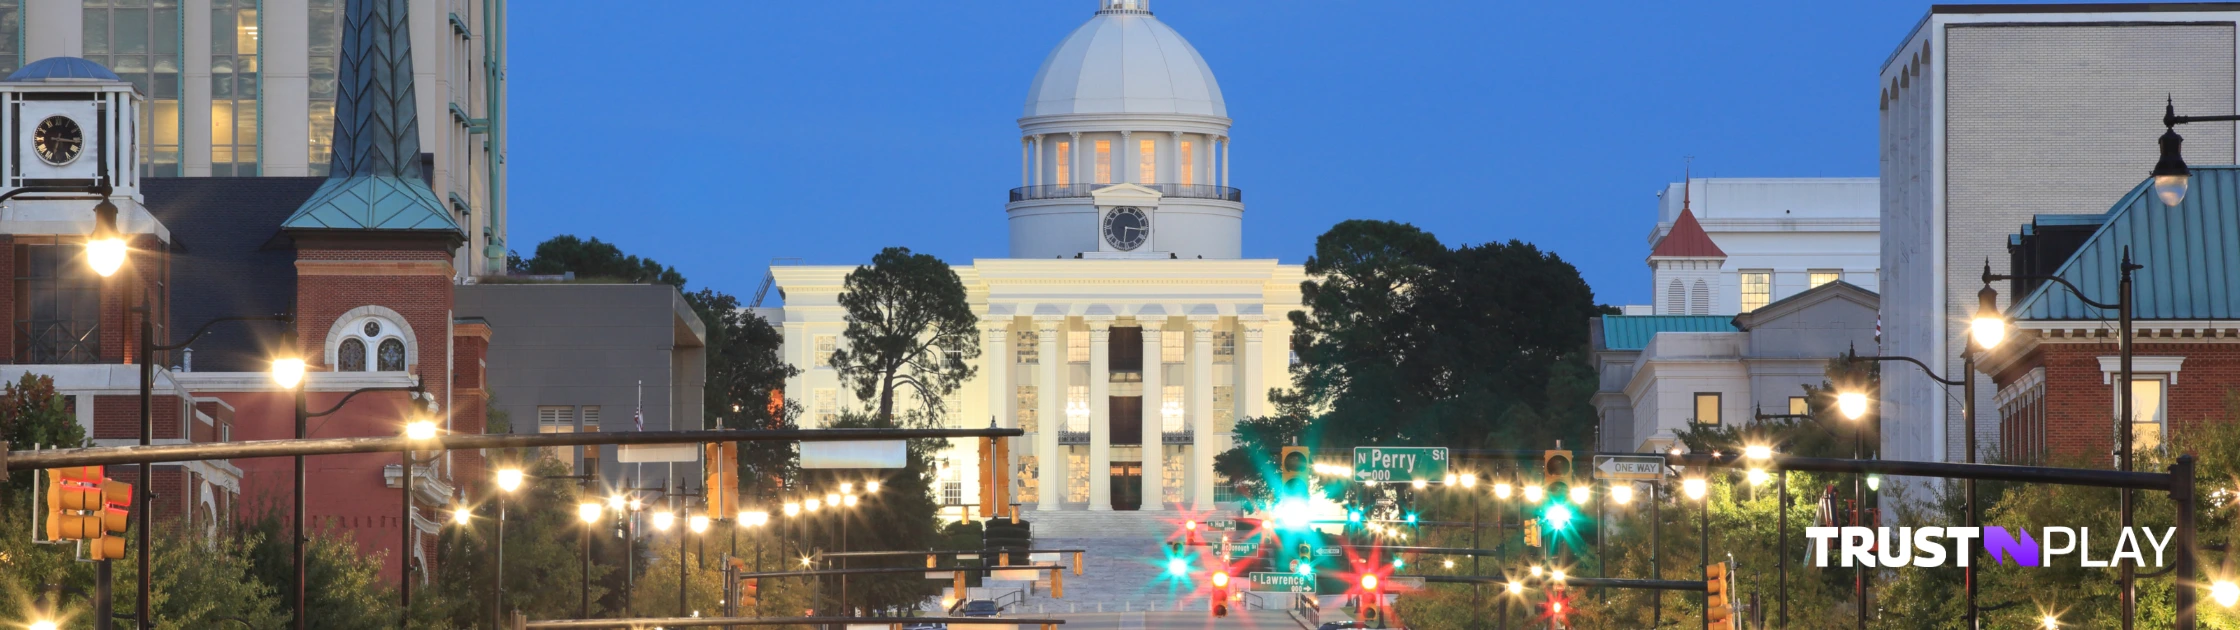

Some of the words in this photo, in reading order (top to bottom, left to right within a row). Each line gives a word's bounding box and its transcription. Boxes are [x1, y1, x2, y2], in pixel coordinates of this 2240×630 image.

[1358, 453, 1366, 464] N
[1371, 449, 1416, 474] Perry
[1432, 449, 1445, 461] St
[1615, 463, 1634, 472] ONE
[1637, 463, 1656, 473] WAY
[1371, 469, 1391, 481] 000
[1252, 574, 1257, 582] S
[1260, 573, 1305, 586] Lawrence
